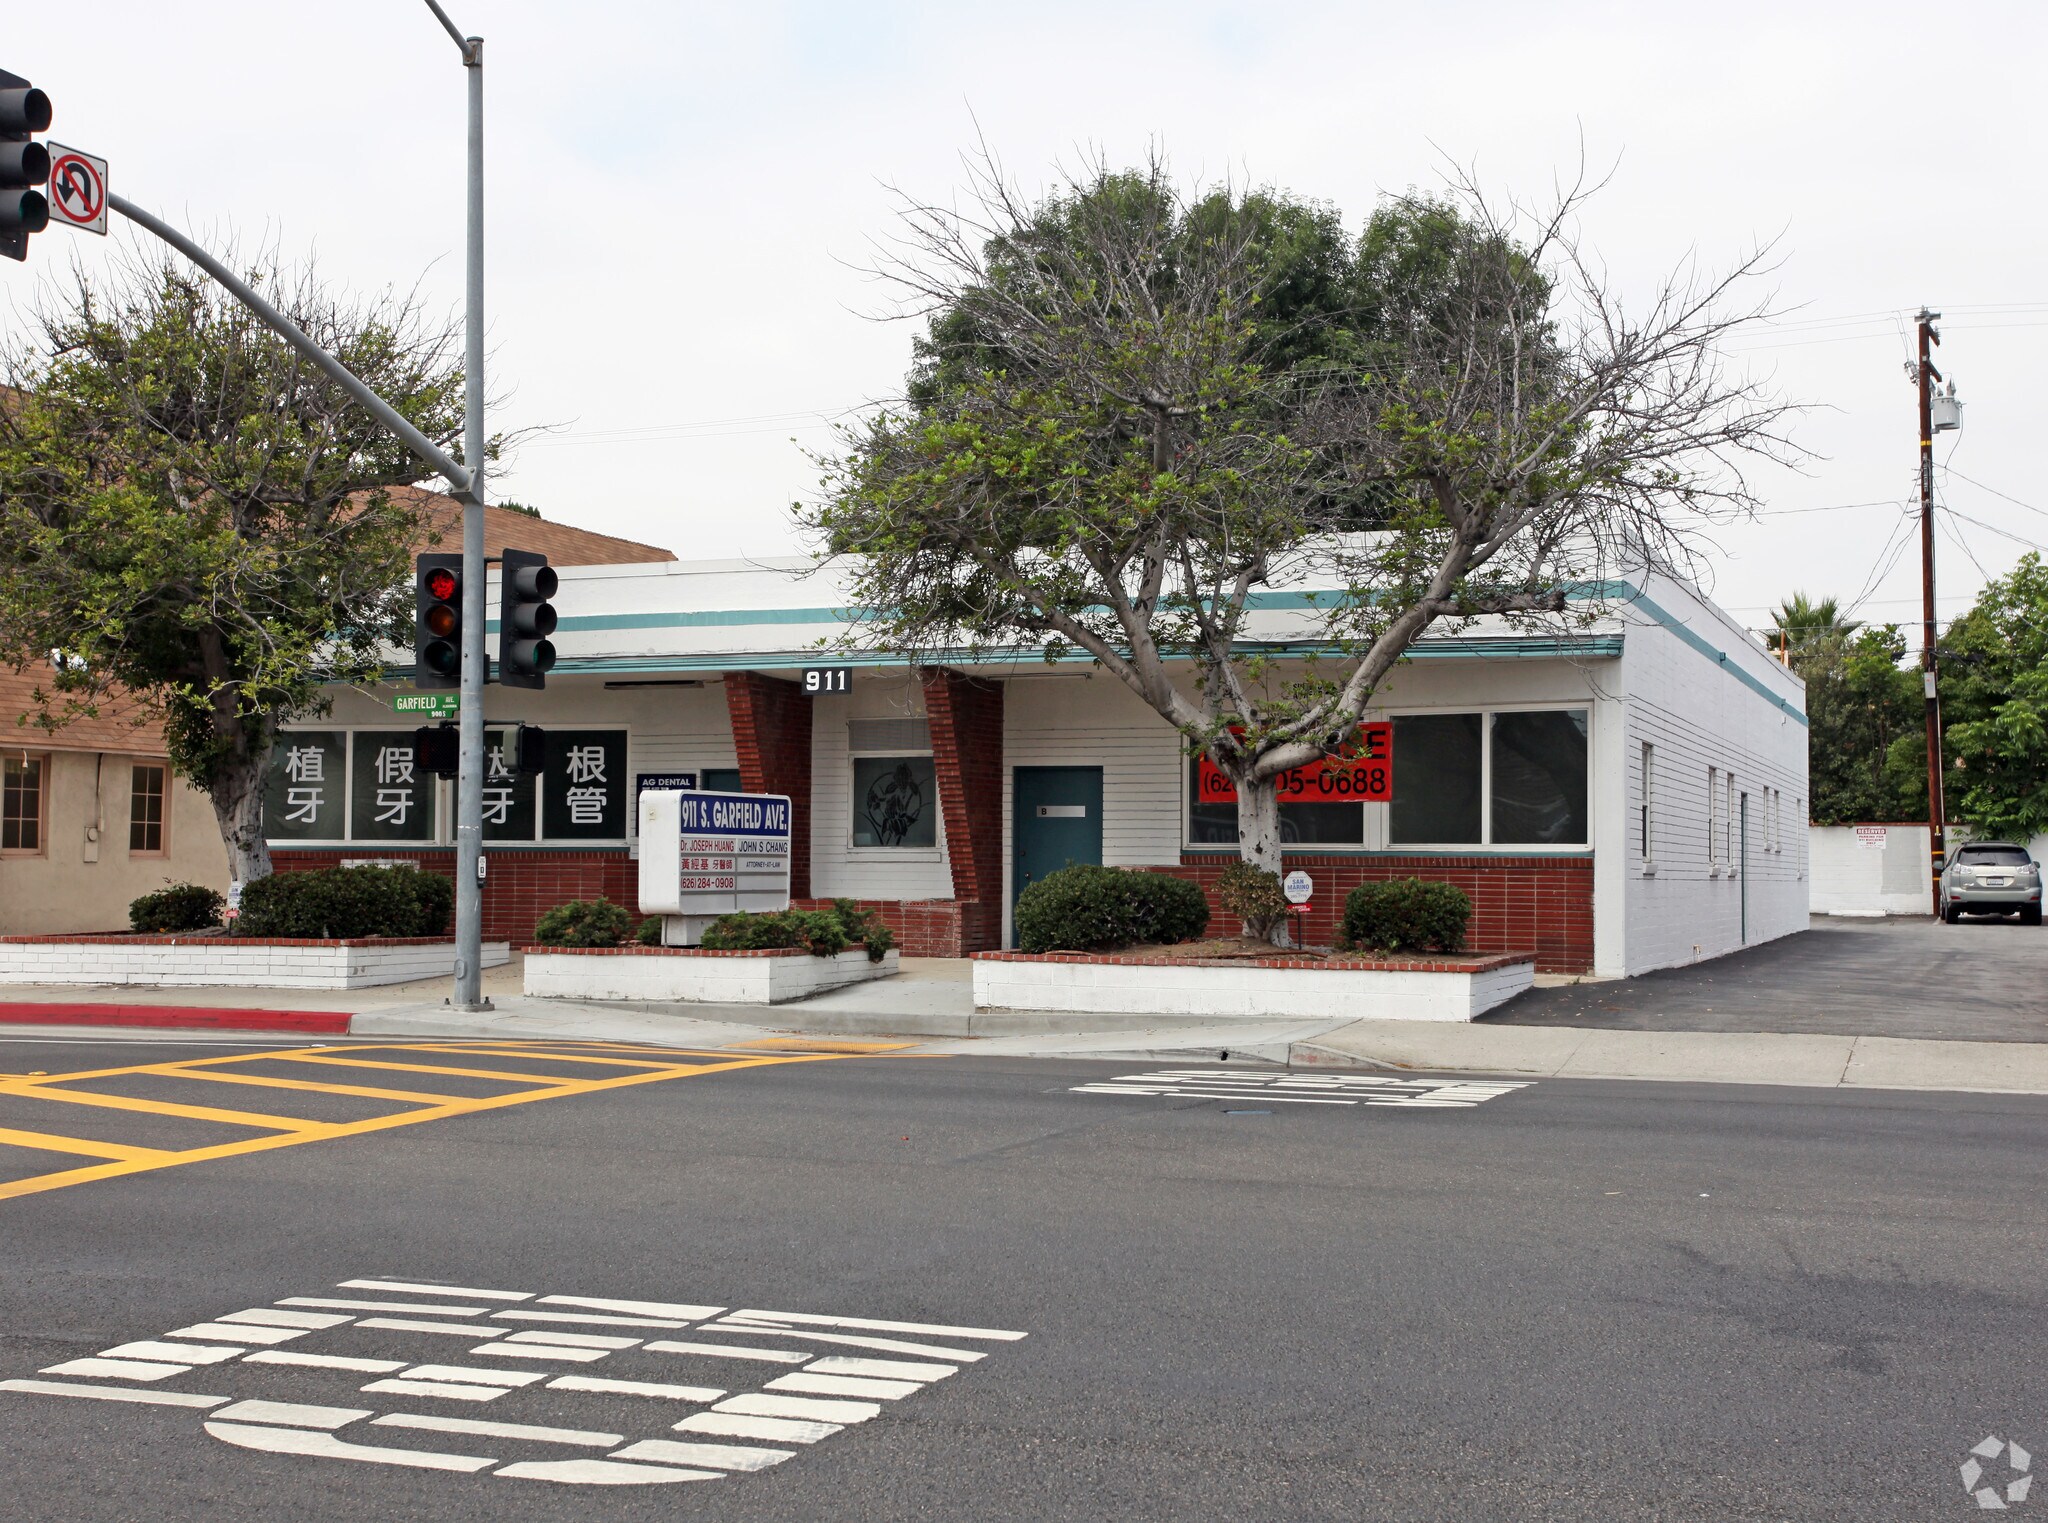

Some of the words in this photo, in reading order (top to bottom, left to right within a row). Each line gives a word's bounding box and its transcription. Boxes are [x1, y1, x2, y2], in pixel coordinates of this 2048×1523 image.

[806, 670, 845, 690] 911
[396, 697, 437, 710] GARFIELD
[285, 745, 325, 823] 植牙
[374, 746, 415, 825] 假牙
[566, 745, 607, 824] 根管
[642, 778, 656, 786] AG
[658, 778, 690, 786] DENTAL
[682, 800, 697, 828] 911
[701, 801, 710, 828] S.
[713, 801, 761, 829] GARFIELD
[764, 804, 787, 830] AVE.
[680, 840, 689, 851] Dr.
[690, 840, 713, 852] JOSEPH
[714, 841, 735, 852] HUANG
[739, 841, 757, 853] JOHN
[759, 842, 764, 853] S
[765, 842, 788, 853] CHANG
[746, 860, 781, 869] ATTORNEY-AT-LAW
